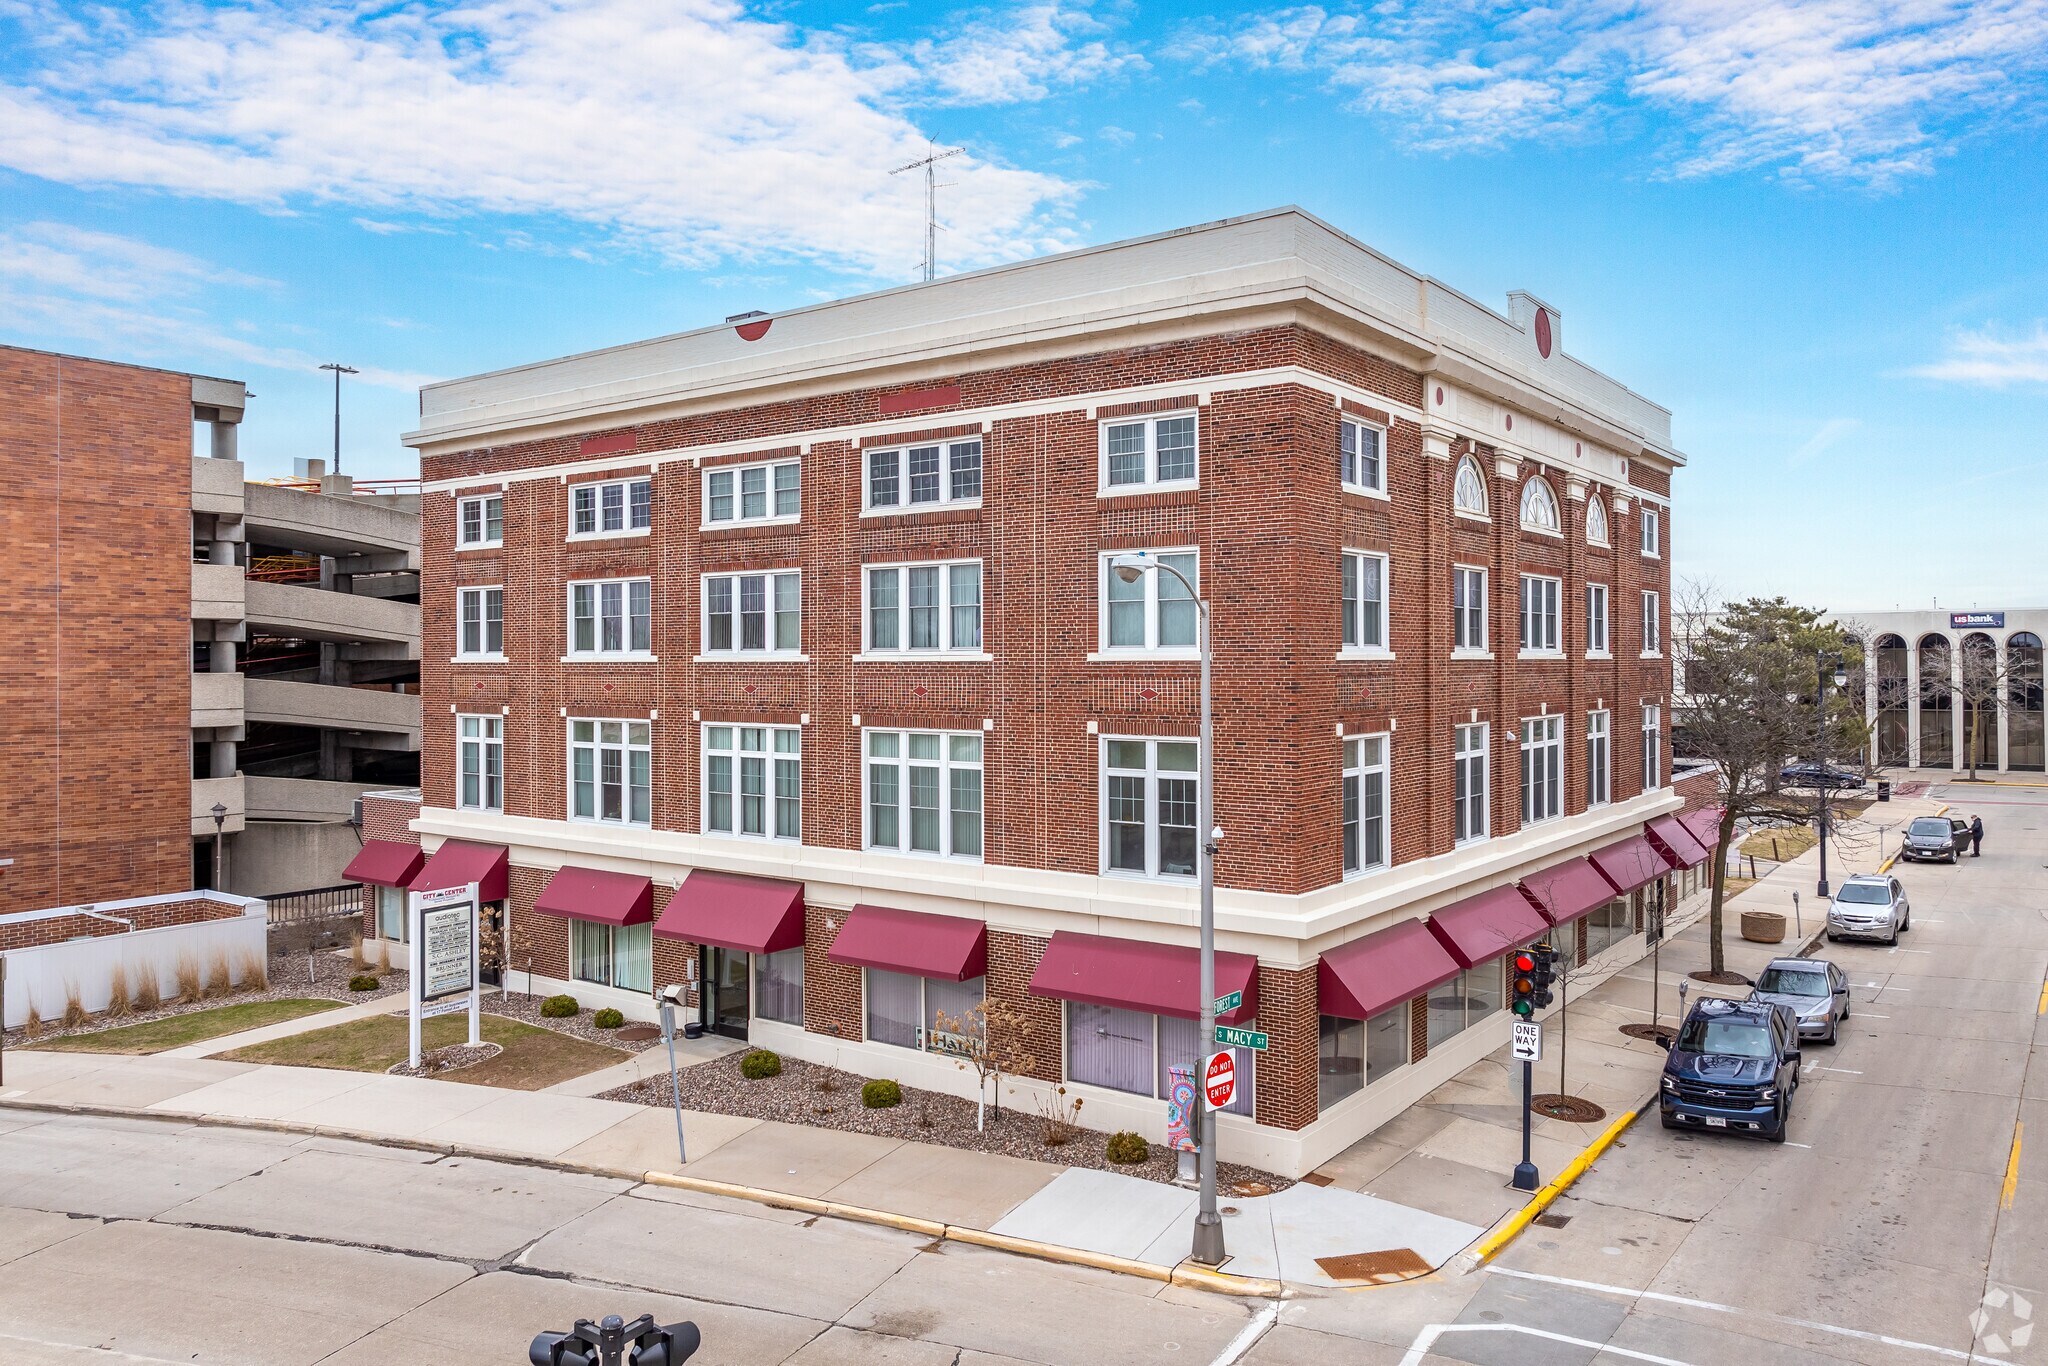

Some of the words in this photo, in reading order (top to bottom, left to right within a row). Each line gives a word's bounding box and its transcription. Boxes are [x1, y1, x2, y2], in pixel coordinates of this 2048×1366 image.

[445, 888, 467, 896] CENTER
[1214, 996, 1230, 1013] FOREST
[1227, 1030, 1252, 1045] MACY
[1516, 1025, 1536, 1036] ONE
[1515, 1035, 1536, 1046] WAY
[1210, 1065, 1218, 1075] DO
[1220, 1061, 1231, 1071] NOT
[1211, 1084, 1230, 1099] ENTER
